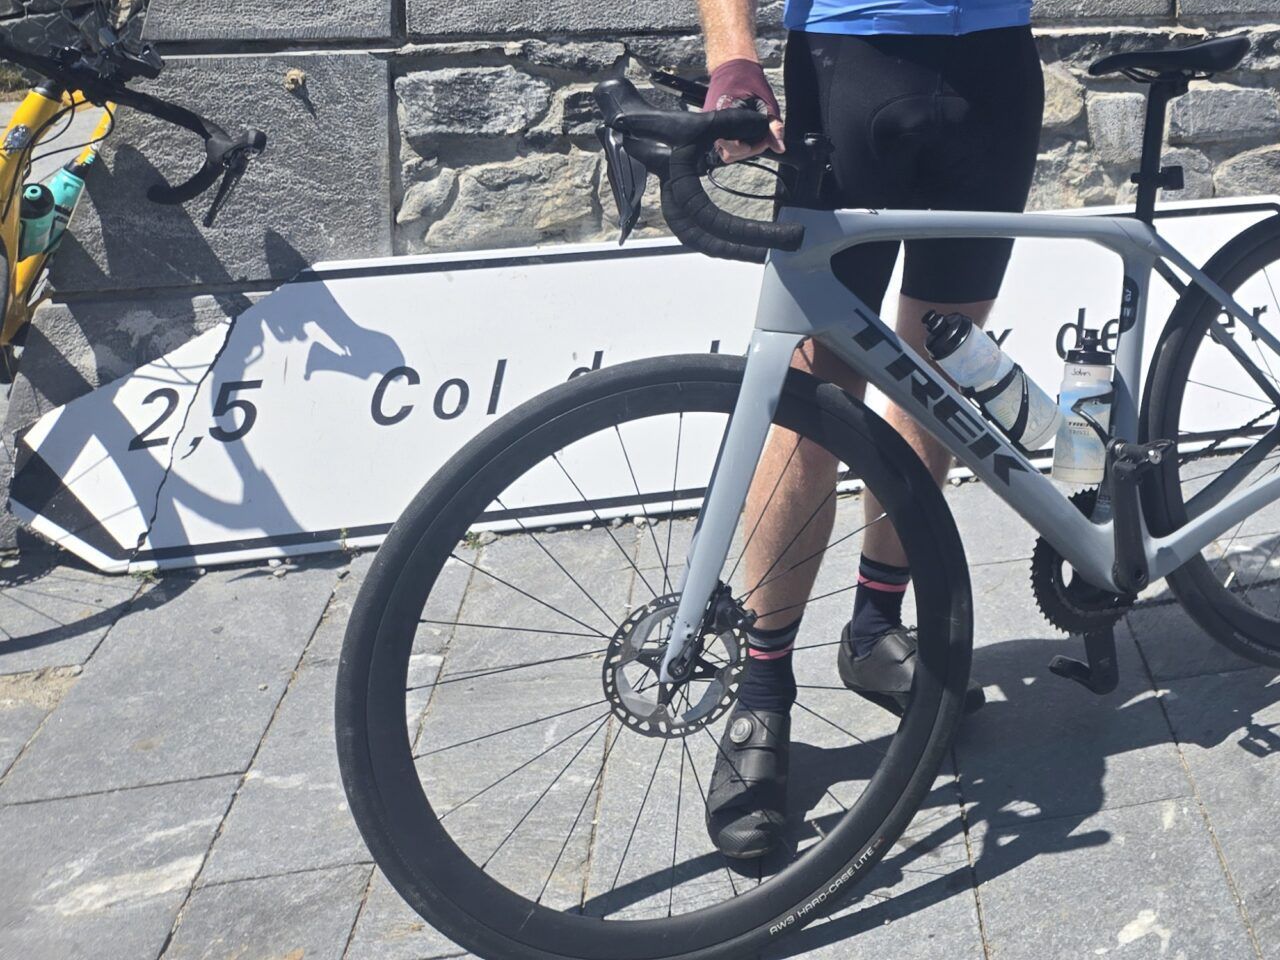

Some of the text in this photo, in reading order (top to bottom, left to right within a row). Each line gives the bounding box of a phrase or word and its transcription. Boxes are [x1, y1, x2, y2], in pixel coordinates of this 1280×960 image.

[127, 379, 263, 460] 2,5
[370, 358, 508, 427] Col
[1056, 308, 1119, 360] de
[853, 307, 1030, 487] TREK
[769, 845, 875, 936] AW3 HARD-CASE LITE
